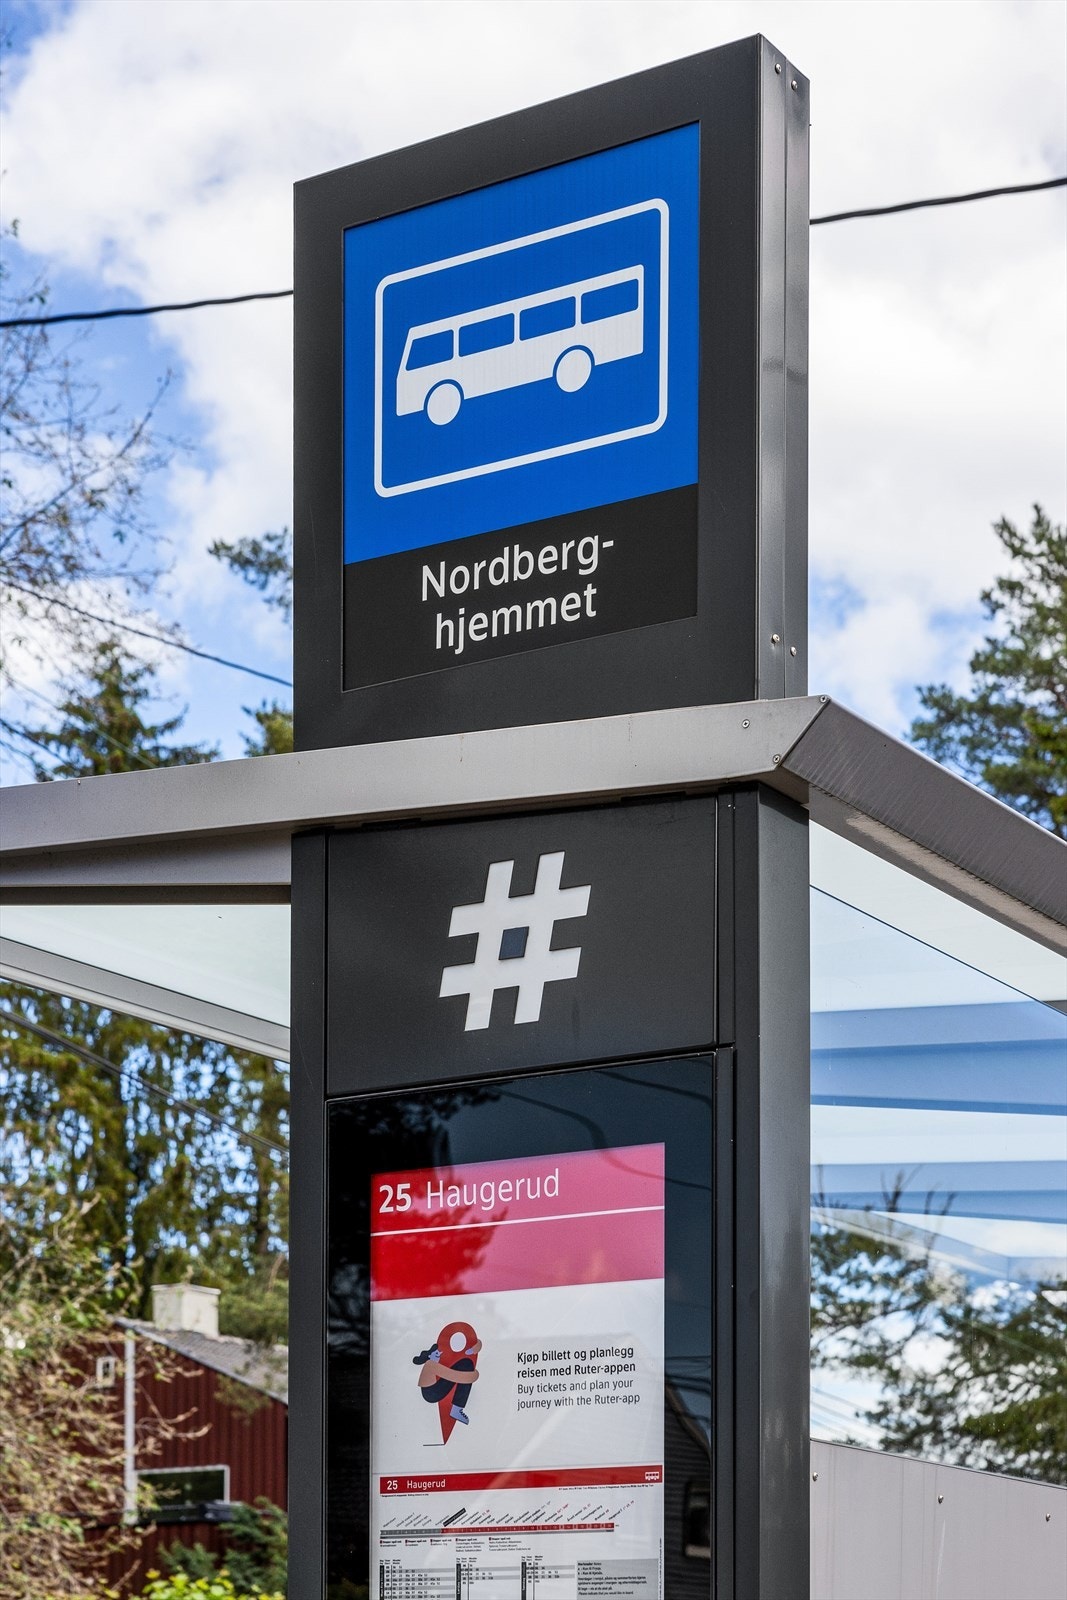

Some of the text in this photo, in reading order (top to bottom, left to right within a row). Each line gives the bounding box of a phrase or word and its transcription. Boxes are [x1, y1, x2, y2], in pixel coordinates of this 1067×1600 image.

[422, 535, 614, 601] Nordberg-
[436, 583, 597, 655] hjemmet
[379, 1168, 560, 1213] 25 Haugerud
[517, 1346, 634, 1364] Kjøp billett og planlegg
[517, 1363, 636, 1378] reisen med Ruter-appen
[517, 1379, 634, 1395] Buy tickets and plan your
[517, 1394, 640, 1411] journey with the Ruter-app
[386, 1479, 446, 1490] 25 Haugerud
